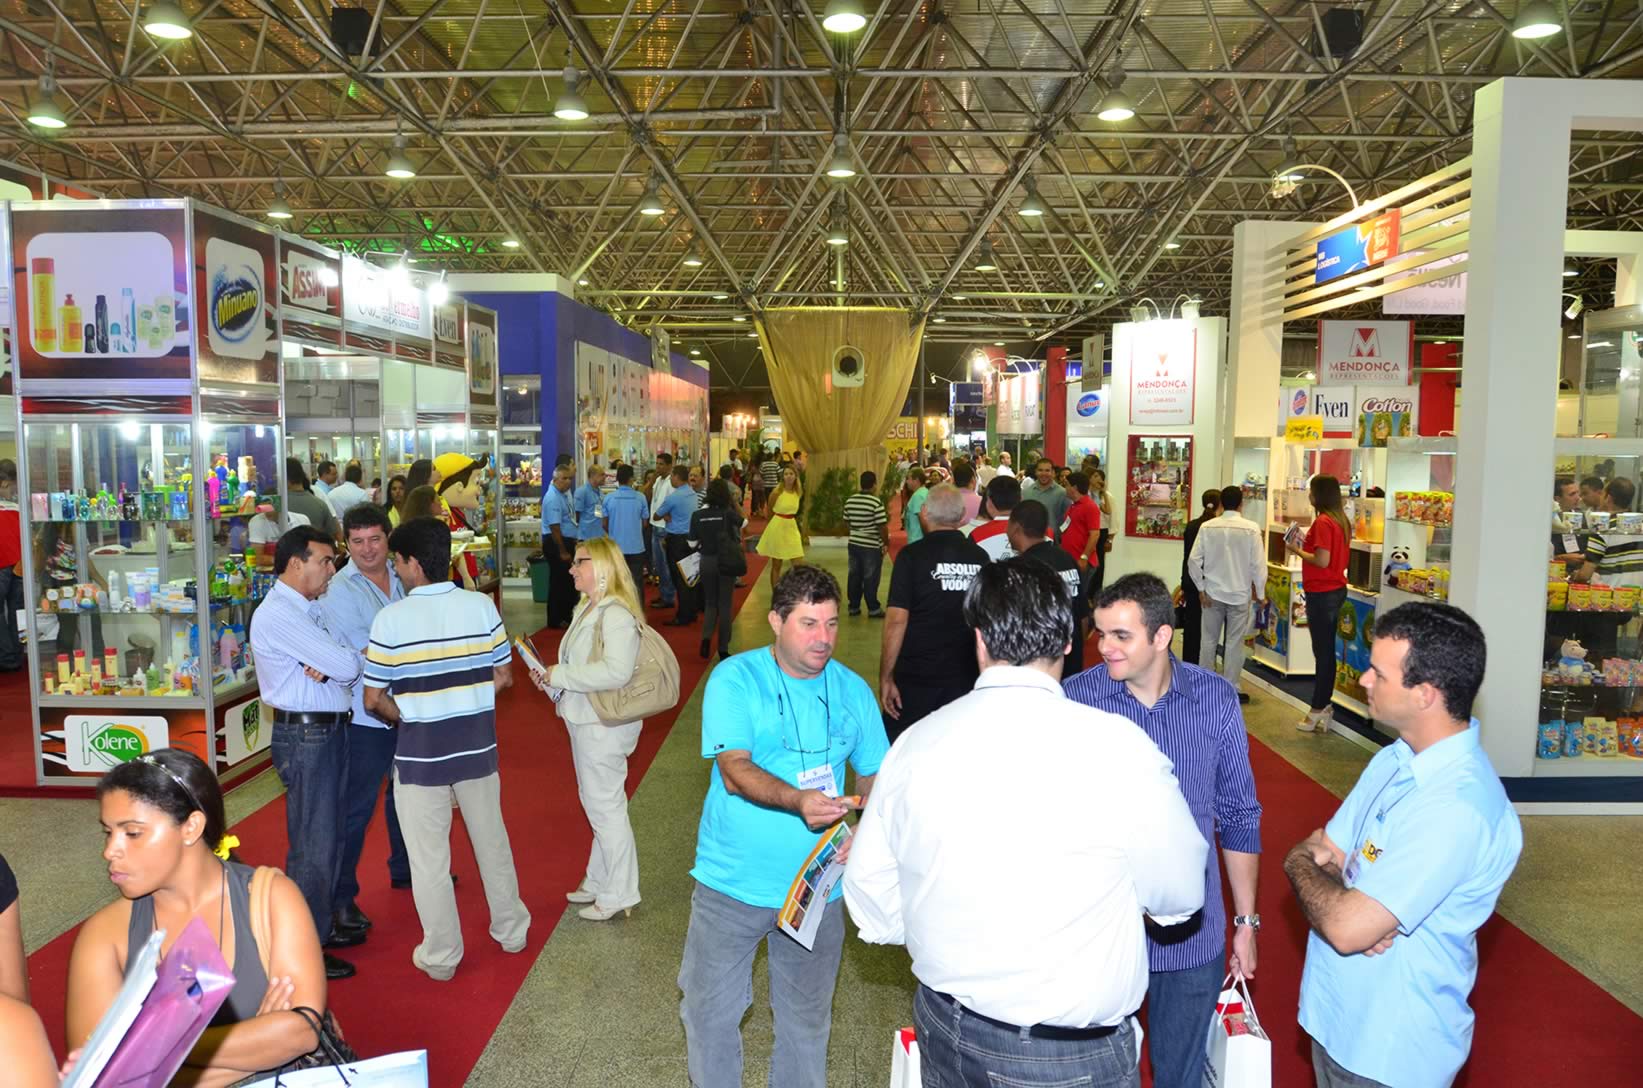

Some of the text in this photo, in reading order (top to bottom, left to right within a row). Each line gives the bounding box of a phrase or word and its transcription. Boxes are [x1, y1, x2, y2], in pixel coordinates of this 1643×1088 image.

[217, 289, 258, 329] Minuano
[1329, 361, 1400, 373] MENDONÇA
[1137, 380, 1187, 389] MENDONÇA
[1315, 394, 1349, 418] Even
[1362, 398, 1413, 413] Cotton
[941, 579, 971, 591] VODK
[81, 721, 139, 766] Kolene
